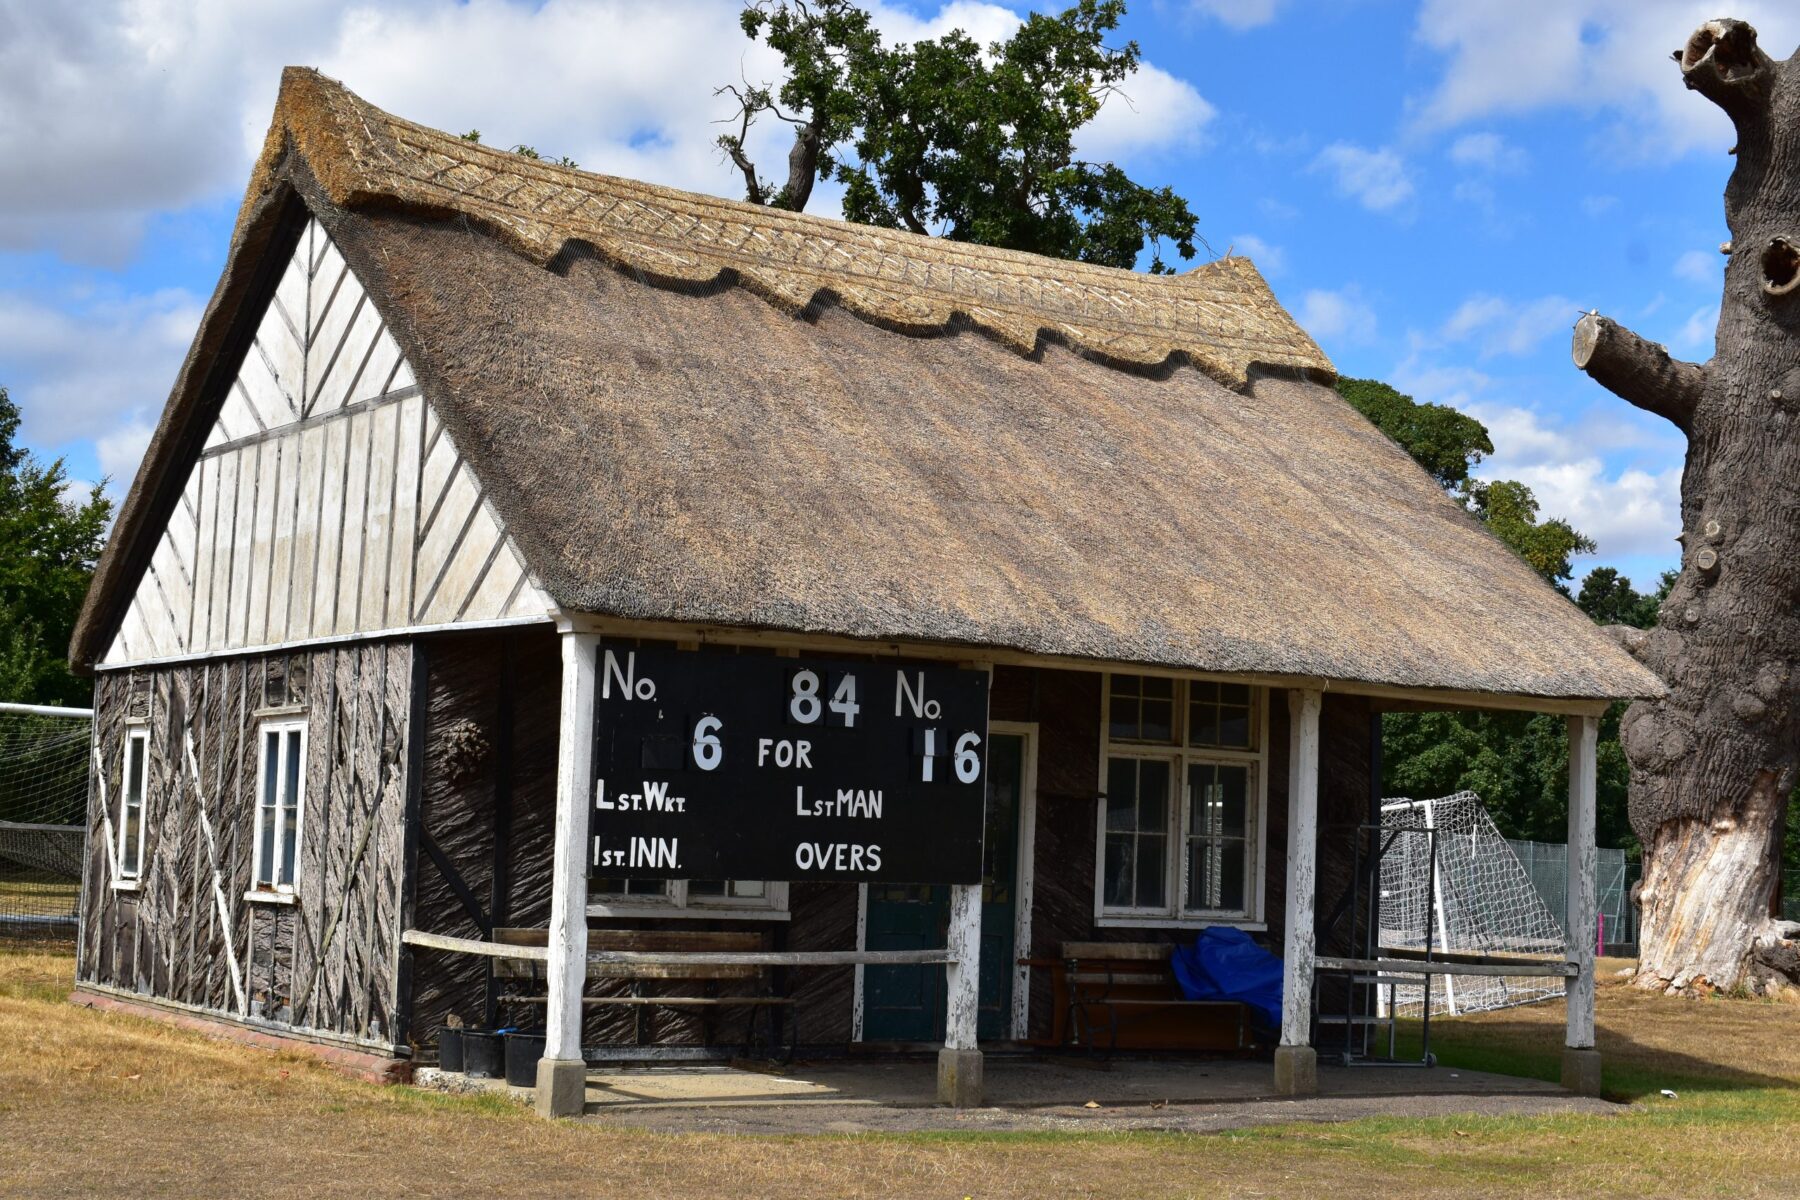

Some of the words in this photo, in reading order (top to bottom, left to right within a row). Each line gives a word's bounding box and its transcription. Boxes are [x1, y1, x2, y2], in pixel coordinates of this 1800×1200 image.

[790, 669, 860, 728] 84
[692, 714, 723, 771] 6
[758, 739, 813, 769] FOR
[922, 727, 982, 784] 16
[836, 788, 883, 819] MAN
[795, 842, 882, 872] OVERS
